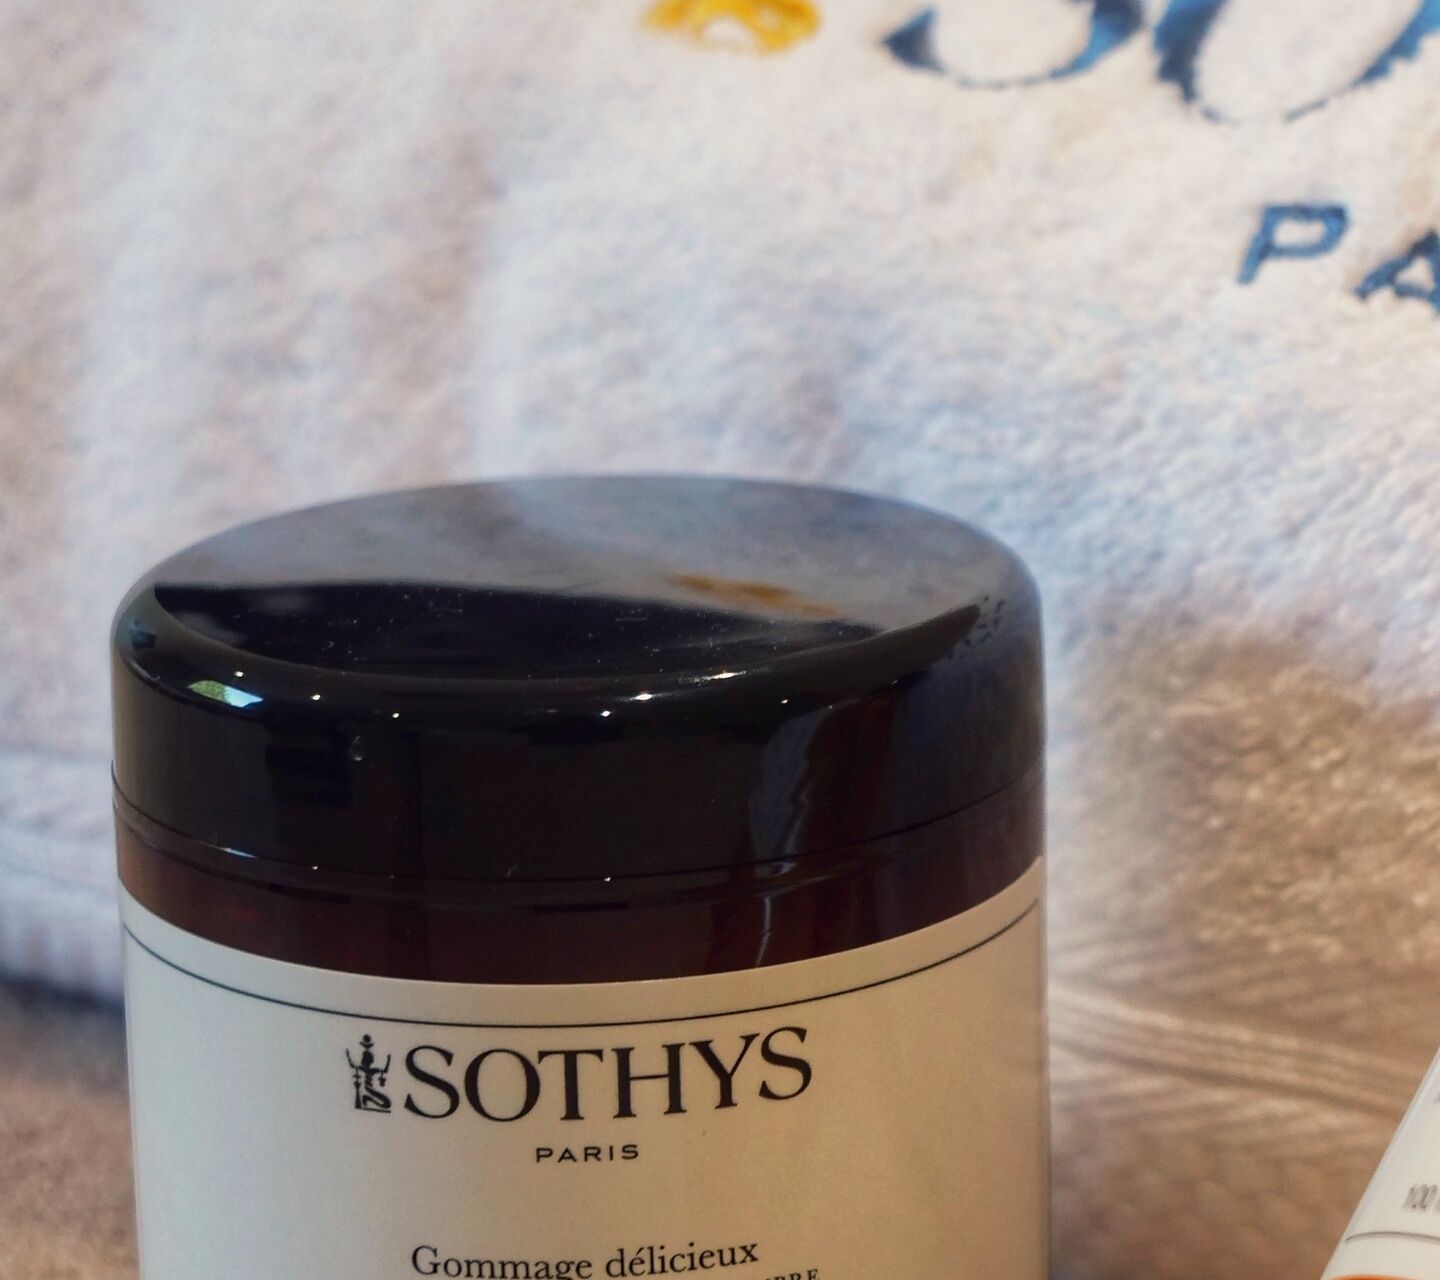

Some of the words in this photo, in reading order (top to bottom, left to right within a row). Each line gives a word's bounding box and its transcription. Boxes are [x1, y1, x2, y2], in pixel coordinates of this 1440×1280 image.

[404, 1027, 812, 1122] SOTHYS
[536, 1144, 639, 1163] PARIS
[605, 1241, 760, 1278] délicieux
